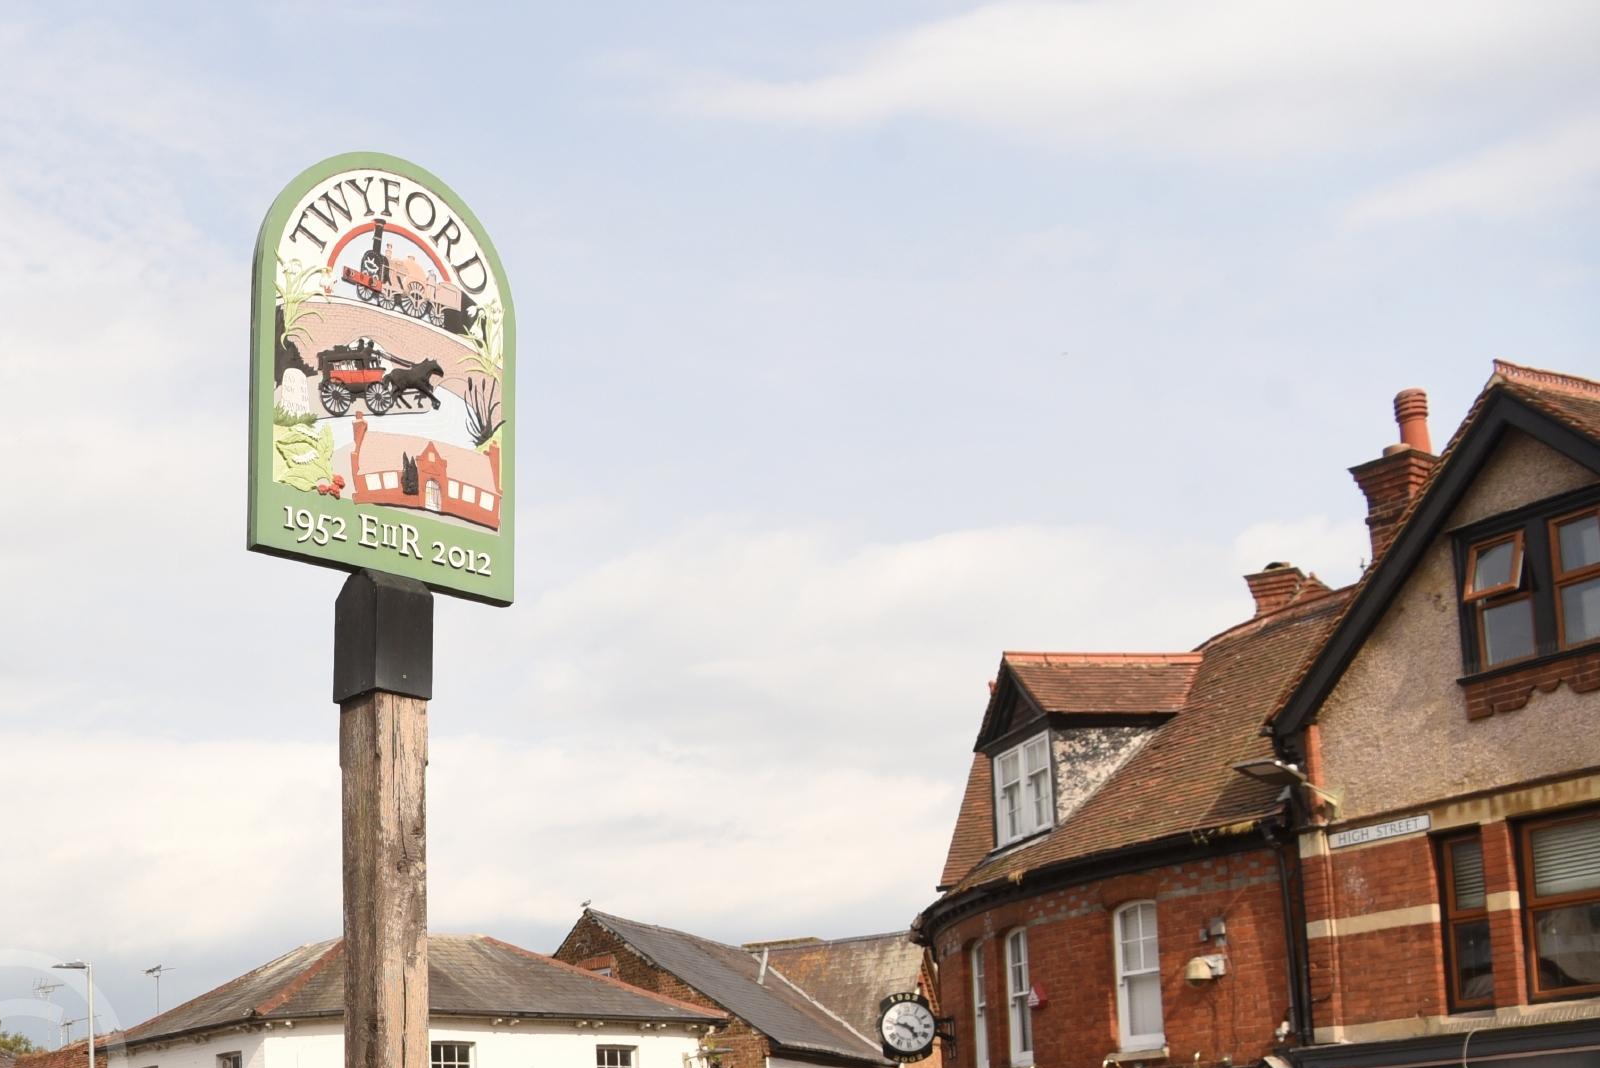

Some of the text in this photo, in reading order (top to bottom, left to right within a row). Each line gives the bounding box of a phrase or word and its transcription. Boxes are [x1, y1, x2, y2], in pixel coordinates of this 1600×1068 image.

[289, 176, 487, 295] TWYFORD
[284, 506, 348, 546] 1952
[431, 541, 492, 576] 2012
[1337, 818, 1420, 845] HIGH STREET
